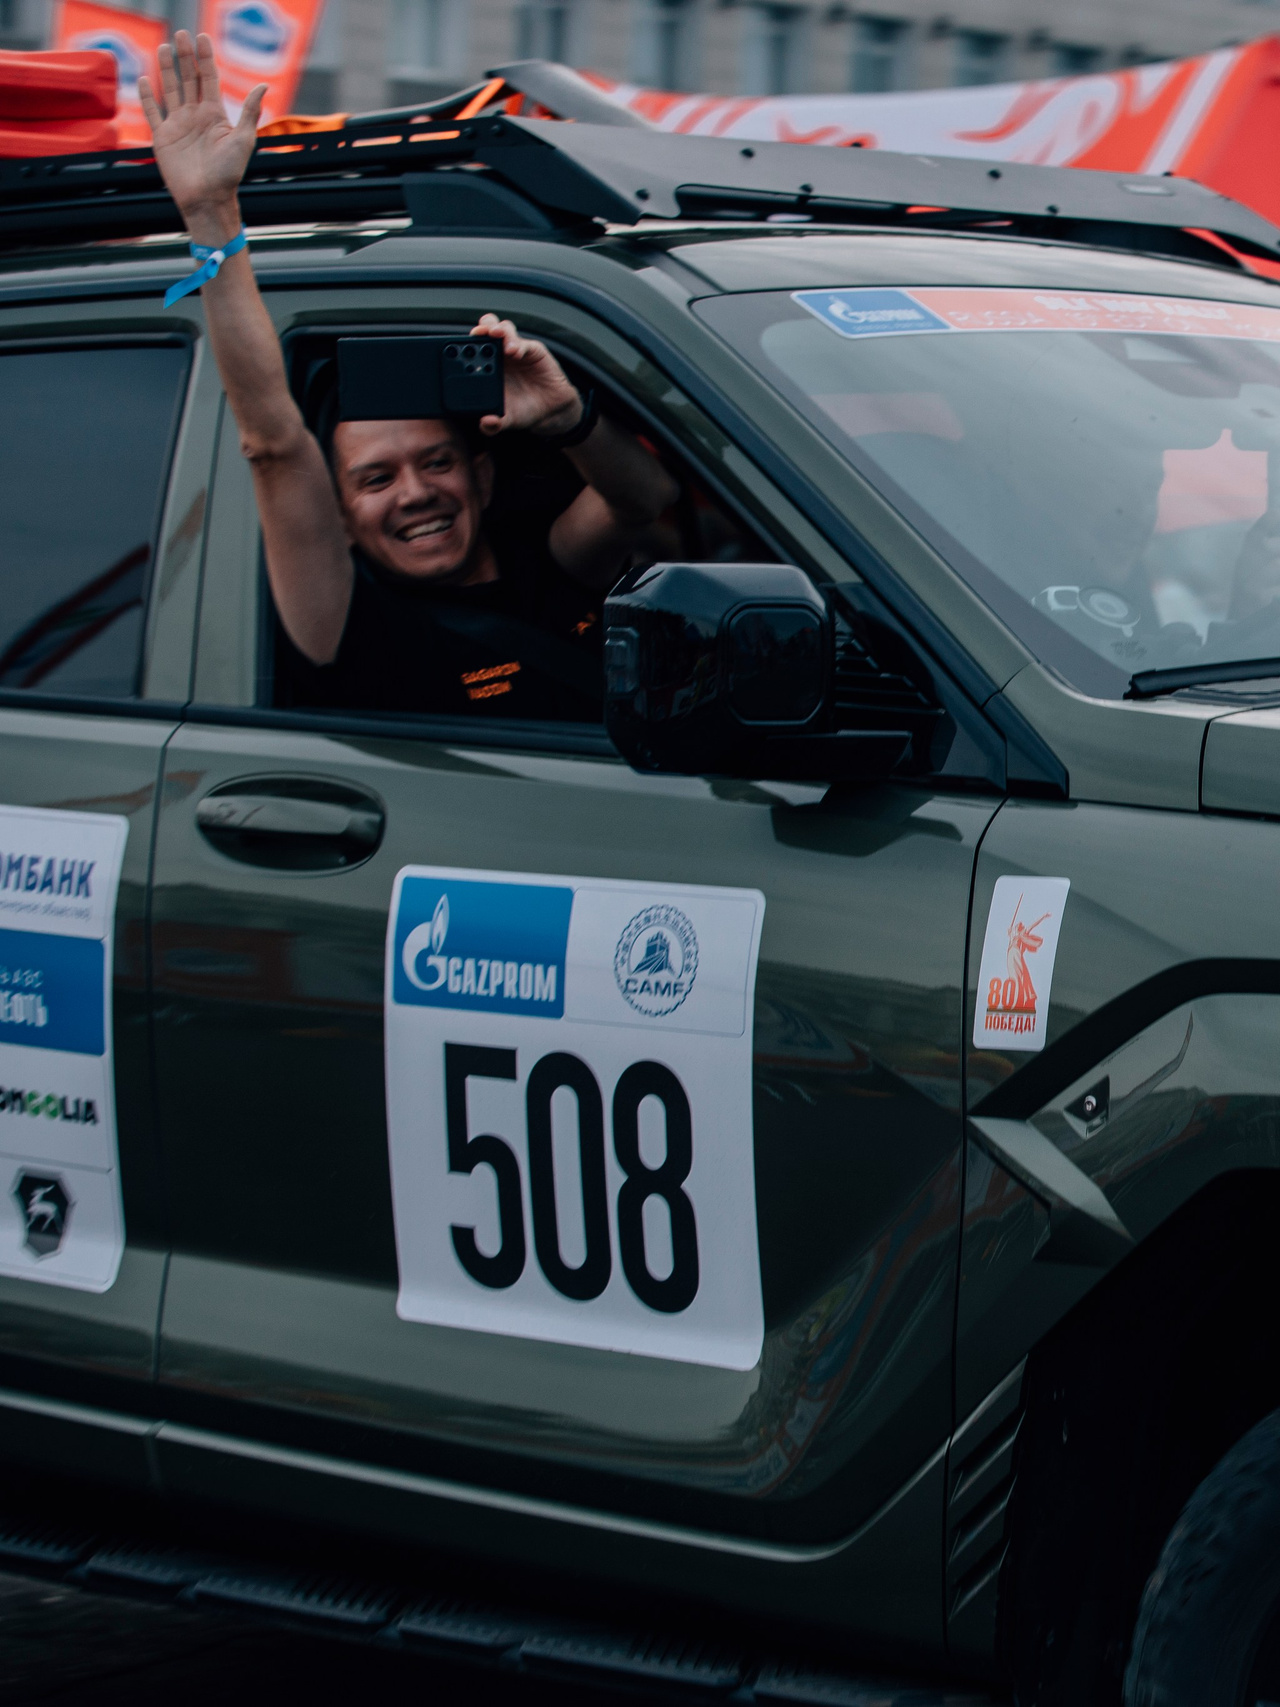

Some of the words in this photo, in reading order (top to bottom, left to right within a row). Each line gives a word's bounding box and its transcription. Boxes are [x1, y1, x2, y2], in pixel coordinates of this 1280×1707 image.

[0, 851, 97, 899] МБАНК
[447, 956, 557, 1002] GAZPROM
[624, 978, 685, 998] CAMF
[987, 977, 1018, 1010] 80
[984, 1014, 1036, 1035] ПОБЕДА!
[444, 1040, 700, 1314] 508
